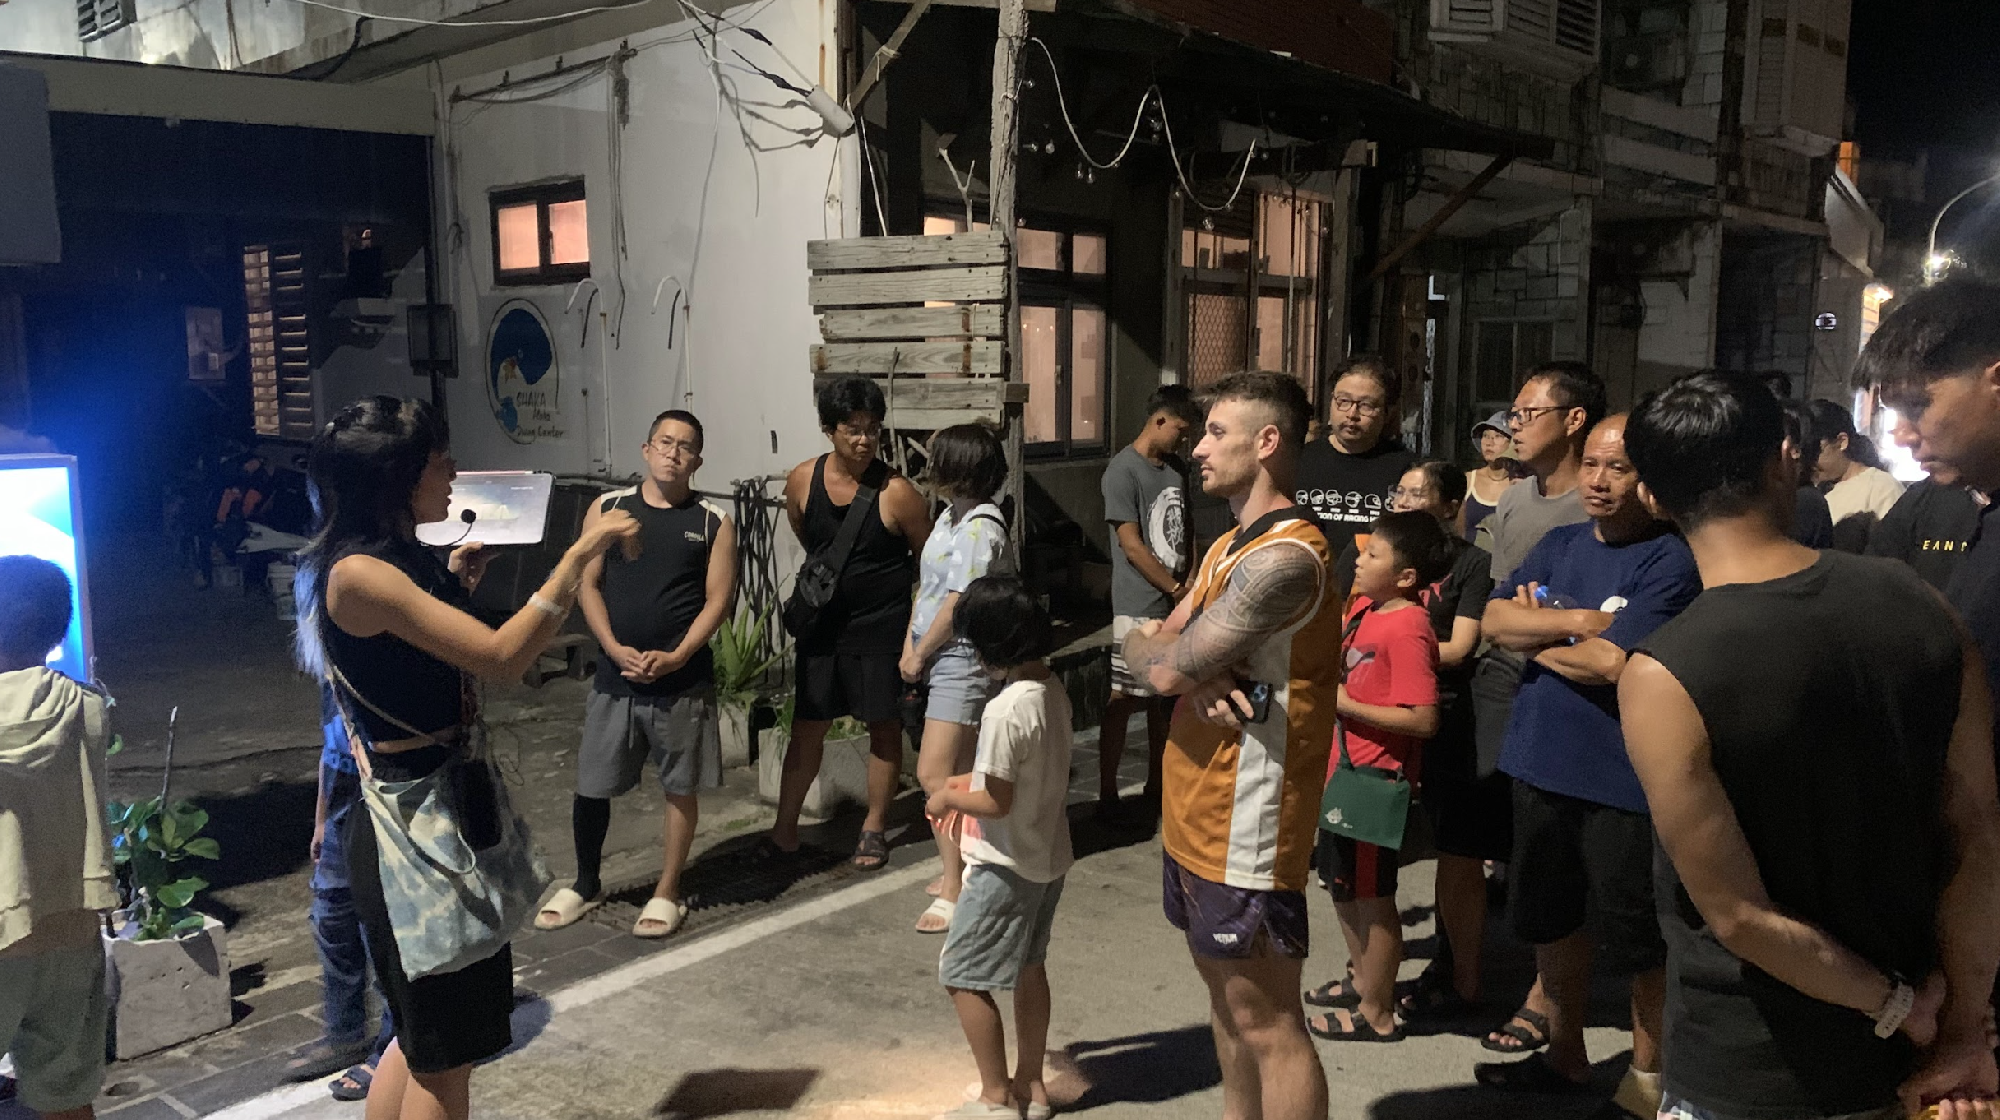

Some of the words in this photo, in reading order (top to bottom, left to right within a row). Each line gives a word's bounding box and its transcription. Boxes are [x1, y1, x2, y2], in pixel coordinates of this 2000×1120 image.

[516, 391, 546, 407] SHAKA
[538, 425, 564, 438] Center
[1333, 513, 1343, 521] OF
